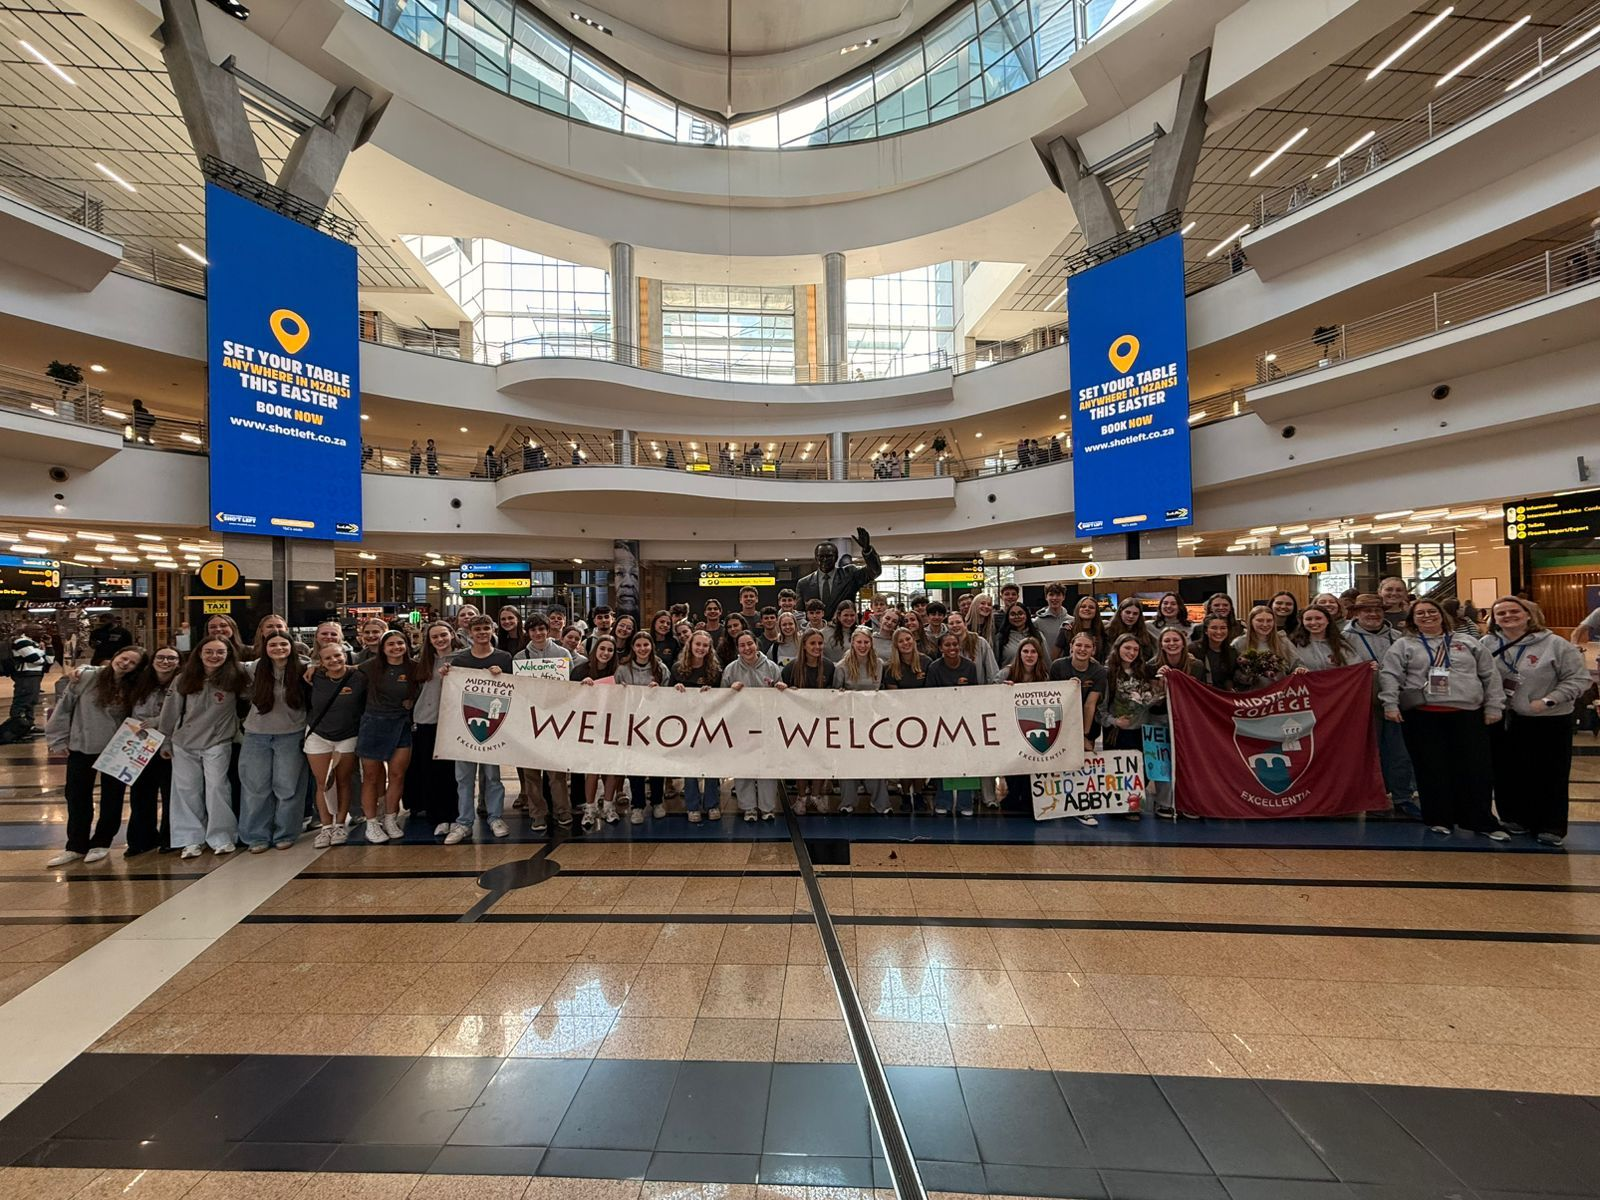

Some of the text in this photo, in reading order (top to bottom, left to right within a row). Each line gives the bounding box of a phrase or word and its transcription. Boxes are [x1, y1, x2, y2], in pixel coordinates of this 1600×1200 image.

[222, 340, 351, 388] SET YOUR TABLE
[222, 356, 351, 399] ANYWHERE IN MZANSI
[1079, 362, 1177, 402] SET YOUR TABLE
[239, 372, 338, 410] THIS EASTER
[1079, 376, 1178, 411] ANYWHERE IN MZANSI
[256, 400, 324, 426] BOOK NOW
[1089, 390, 1166, 421] THIS EASTER
[229, 416, 347, 447] www.shotleft.co.za
[1101, 414, 1153, 436] BOOK NOW
[1084, 427, 1175, 454] www.shotleft.co.za
[464, 685, 513, 696] COLLEGE
[465, 678, 515, 690] MIDSTREAM
[1014, 690, 1062, 699] MIDSTREAM
[1015, 698, 1061, 706] COLLEGE
[1234, 698, 1311, 718] COLLEGE
[530, 705, 734, 748] WELKOM
[778, 712, 1001, 749] WELCOME
[456, 735, 506, 752] EXCELLENTIA
[1018, 748, 1067, 762] EXCELLENTIA
[1113, 756, 1138, 775] IN
[1032, 774, 1143, 797] SUID-AFRIKA
[1064, 791, 1123, 812] ABBY!
[1240, 789, 1311, 808] EXCELLENTIA
